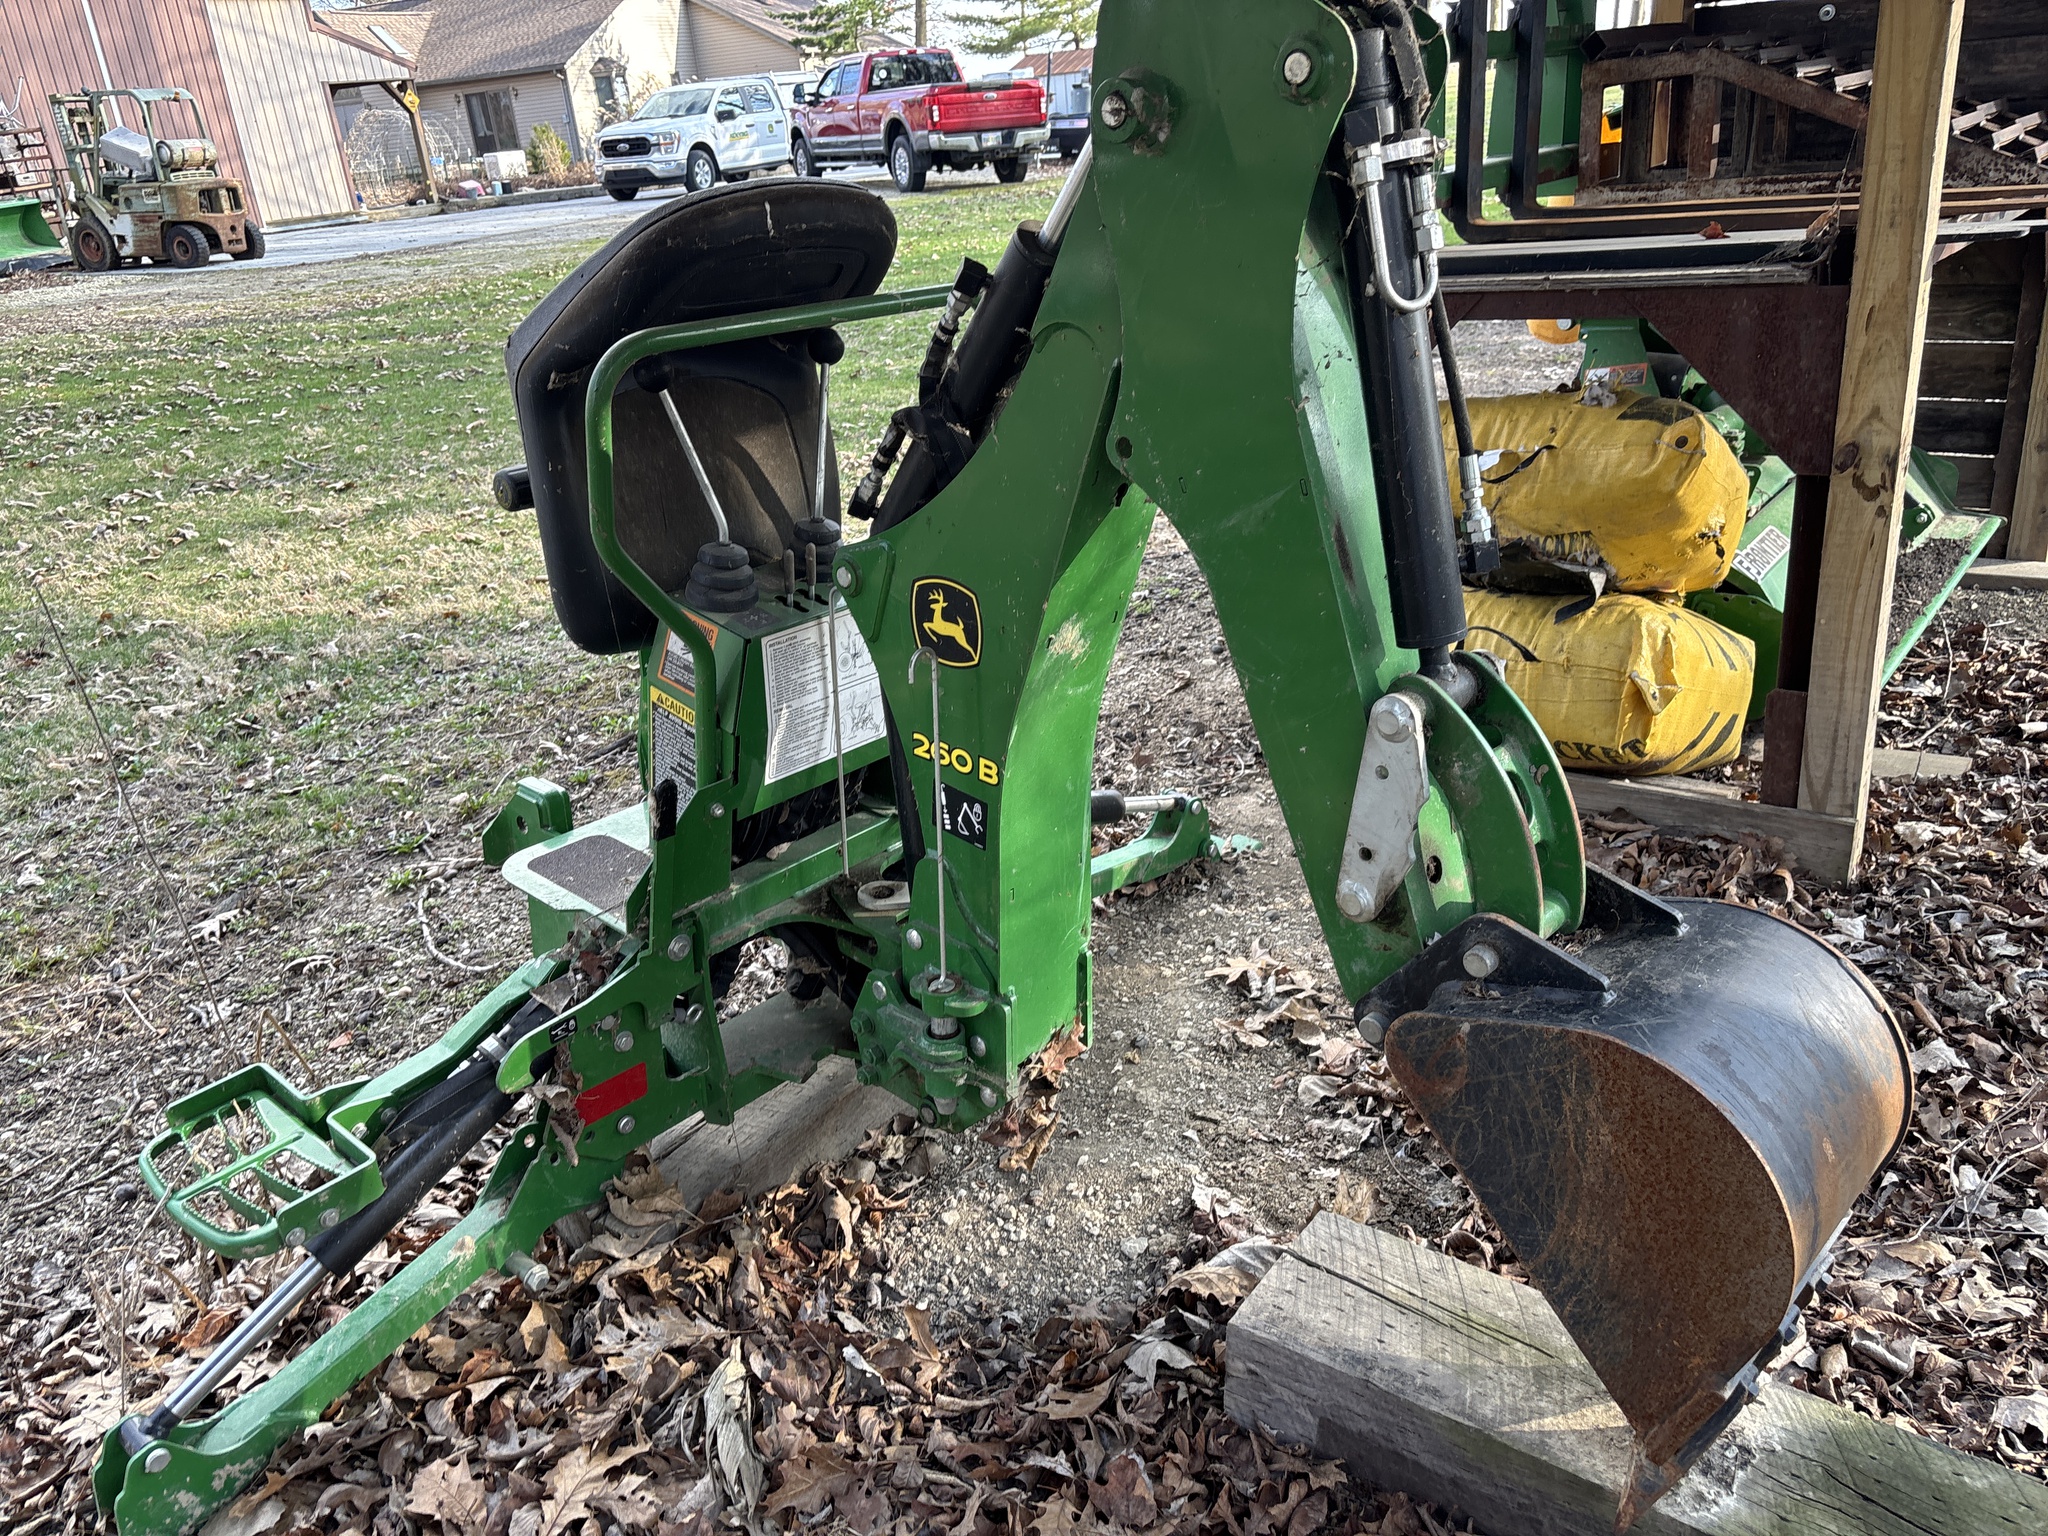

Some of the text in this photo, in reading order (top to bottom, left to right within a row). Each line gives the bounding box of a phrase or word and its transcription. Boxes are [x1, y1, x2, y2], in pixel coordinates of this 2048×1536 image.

[664, 697, 694, 723] CAUTIO
[912, 732, 1000, 787] 260 B
